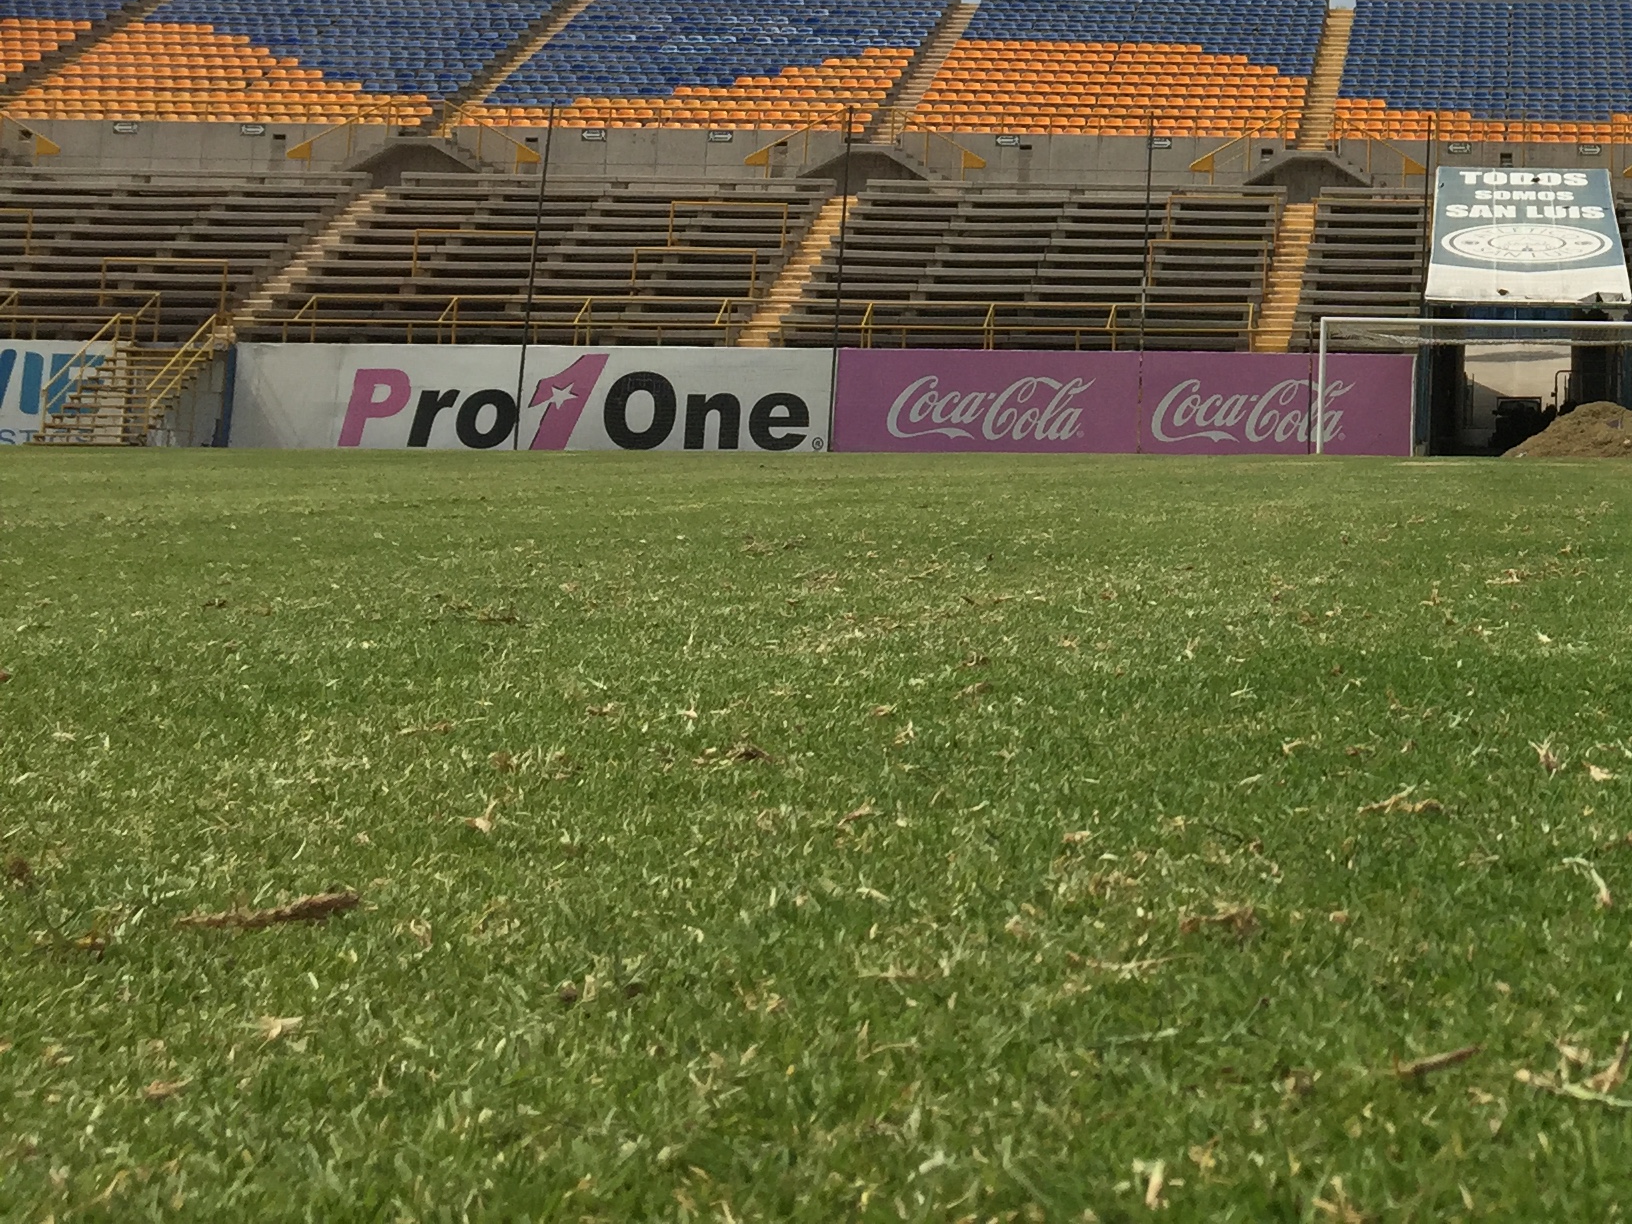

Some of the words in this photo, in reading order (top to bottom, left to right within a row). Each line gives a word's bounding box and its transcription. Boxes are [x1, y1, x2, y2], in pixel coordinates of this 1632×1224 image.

[1459, 171, 1588, 187] TODOS
[1474, 189, 1575, 201] SOMOS
[1446, 204, 1517, 219] SAN
[1526, 205, 1605, 219] LUIS
[886, 375, 1097, 441] Coca-Cola
[1151, 378, 1356, 443] Coca-Cola
